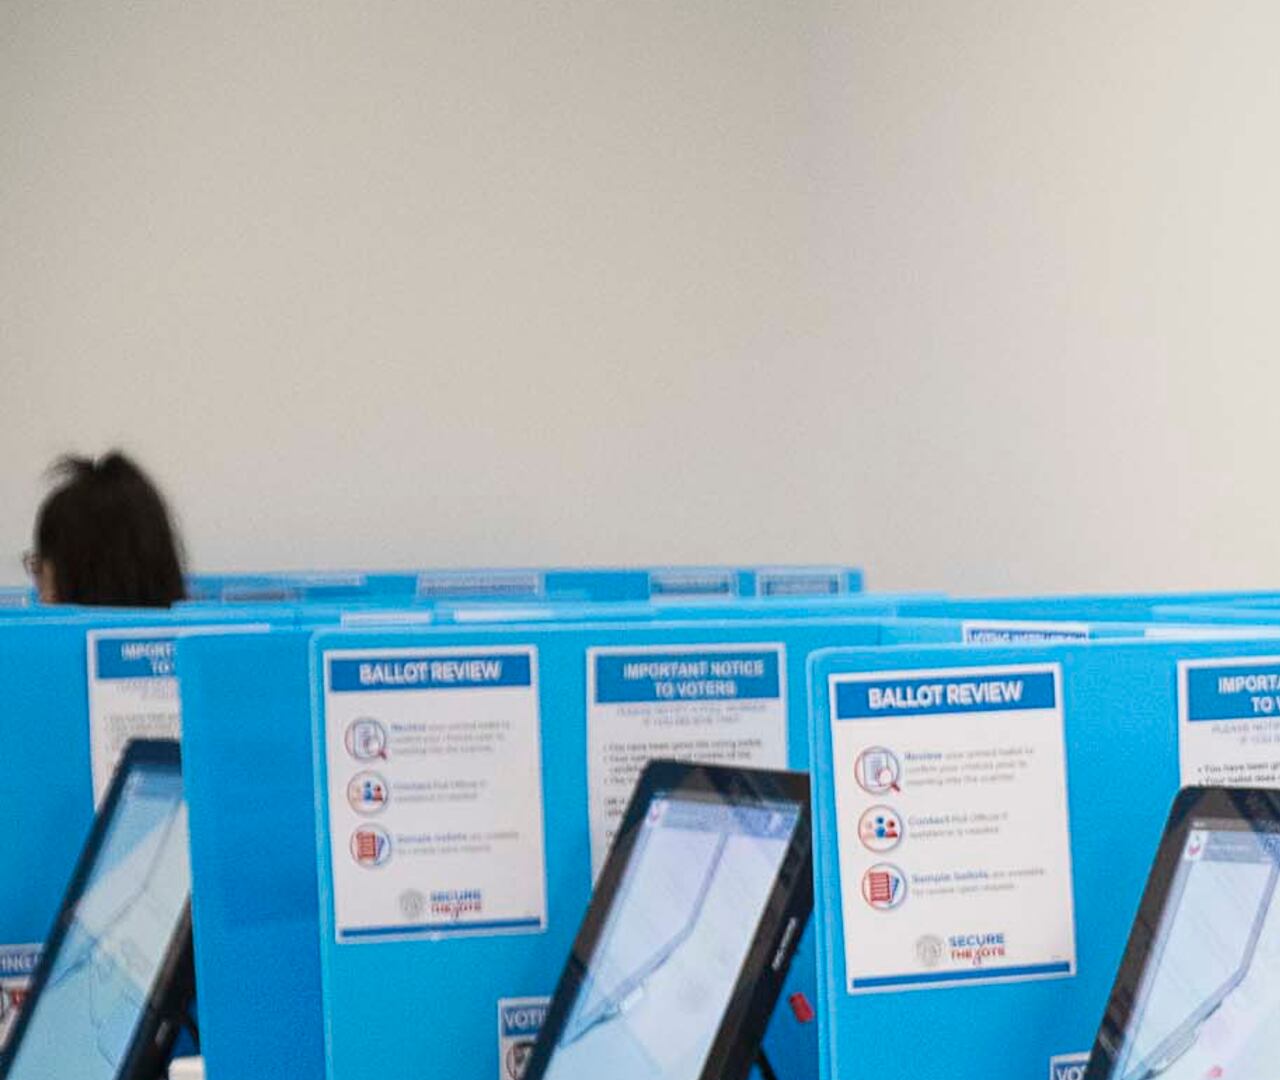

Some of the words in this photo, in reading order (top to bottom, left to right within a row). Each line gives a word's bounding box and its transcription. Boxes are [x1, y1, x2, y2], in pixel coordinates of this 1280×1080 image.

[359, 662, 428, 684] BALLOT
[432, 661, 501, 682] REVIEW
[624, 661, 708, 680] IMPORTANT
[711, 660, 764, 676] NOTICE
[656, 682, 674, 697] TO
[677, 681, 737, 697] VOTERS
[868, 684, 943, 709] BALLOT
[947, 681, 1023, 705] REVIEW
[1251, 696, 1273, 713] TO
